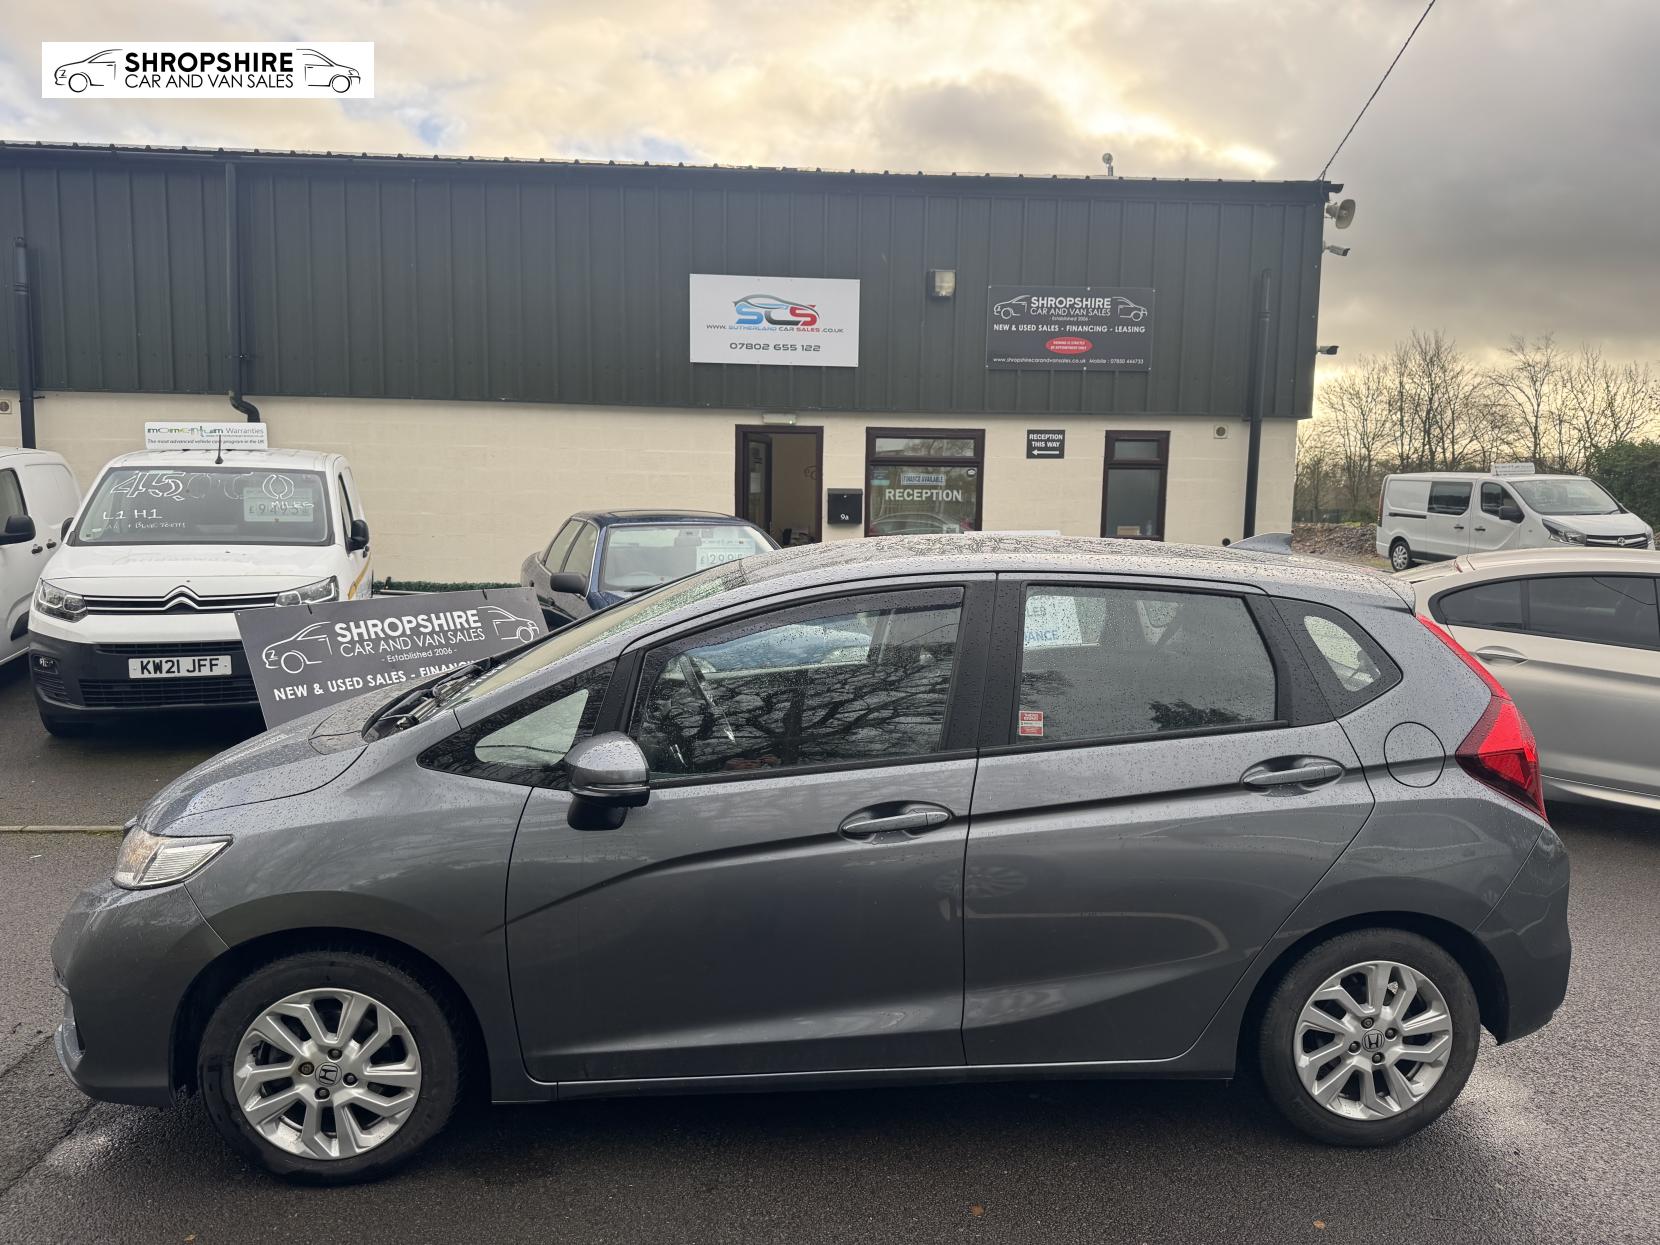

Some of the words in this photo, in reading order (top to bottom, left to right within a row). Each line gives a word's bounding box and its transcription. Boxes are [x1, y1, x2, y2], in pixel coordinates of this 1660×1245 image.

[1030, 296, 1112, 308] SHROPSHIRE
[736, 304, 818, 326] SCS
[730, 342, 770, 351] 07802
[773, 344, 798, 352] 655
[885, 488, 962, 502] RECEPTION
[334, 610, 482, 642] SHROPSHIRE
[340, 641, 374, 657] CAR
[378, 637, 412, 653] AND
[413, 632, 446, 648] VAN
[448, 628, 486, 644] SALES
[387, 650, 434, 664] Established
[434, 647, 453, 658] 2006
[140, 658, 181, 675] KW21
[186, 658, 220, 673] JFF
[273, 685, 308, 701] NEW
[313, 683, 324, 695] &
[327, 676, 364, 693] USED
[368, 670, 407, 688] SALES
